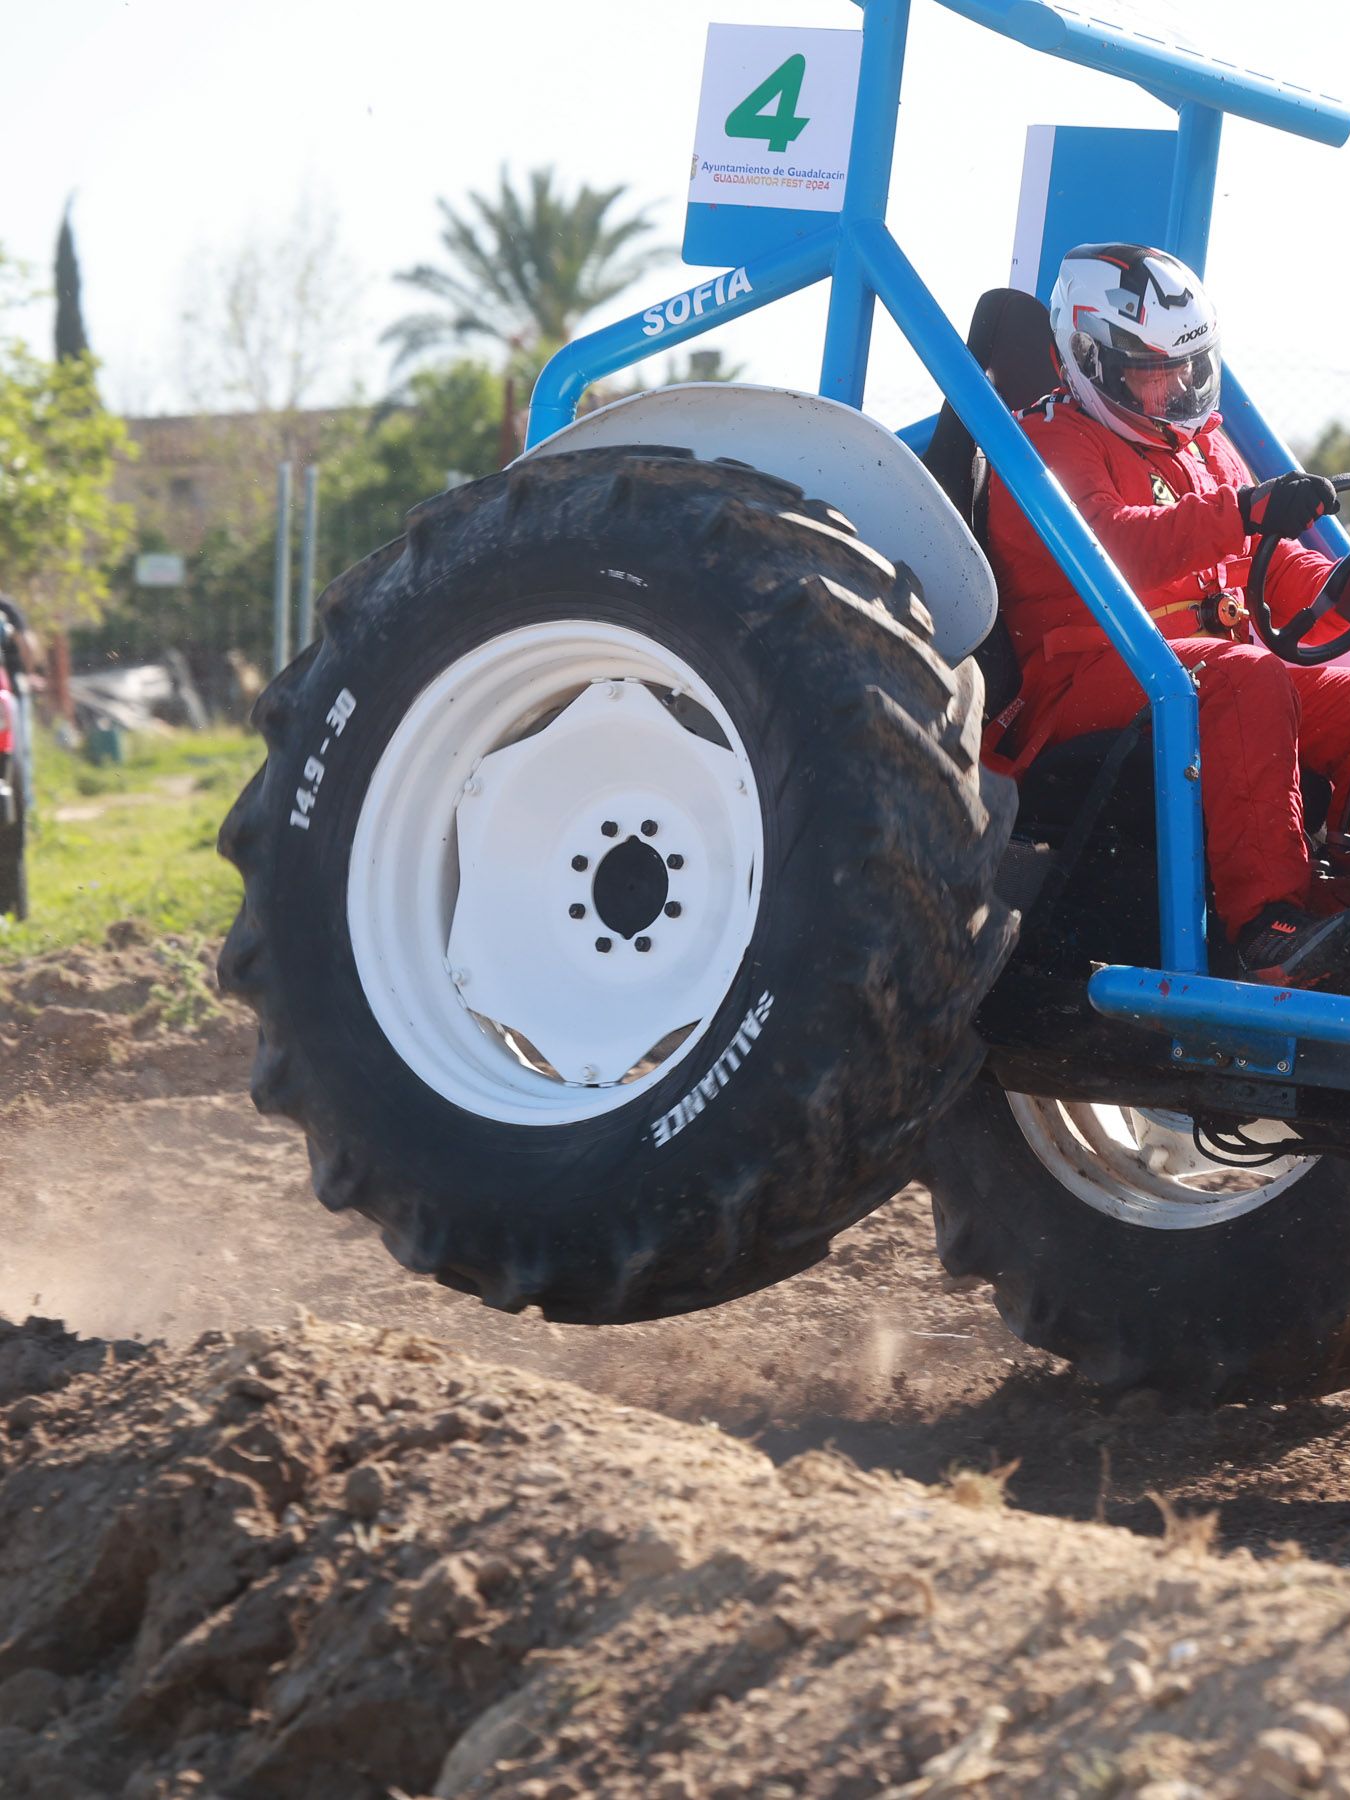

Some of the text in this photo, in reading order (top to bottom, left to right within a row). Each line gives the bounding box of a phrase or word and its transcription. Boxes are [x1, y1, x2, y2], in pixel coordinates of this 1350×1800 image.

[724, 53, 811, 152] 4
[701, 161, 770, 176] Ayuntamiento
[772, 165, 785, 176] de
[713, 173, 830, 190] GUADAMOTOR FEST 2024
[642, 266, 753, 336] SOFIA
[1172, 322, 1209, 346] AXXIS
[289, 755, 325, 831] 14.9
[326, 687, 357, 738] 30
[650, 1008, 763, 1149] ALLIANCE
